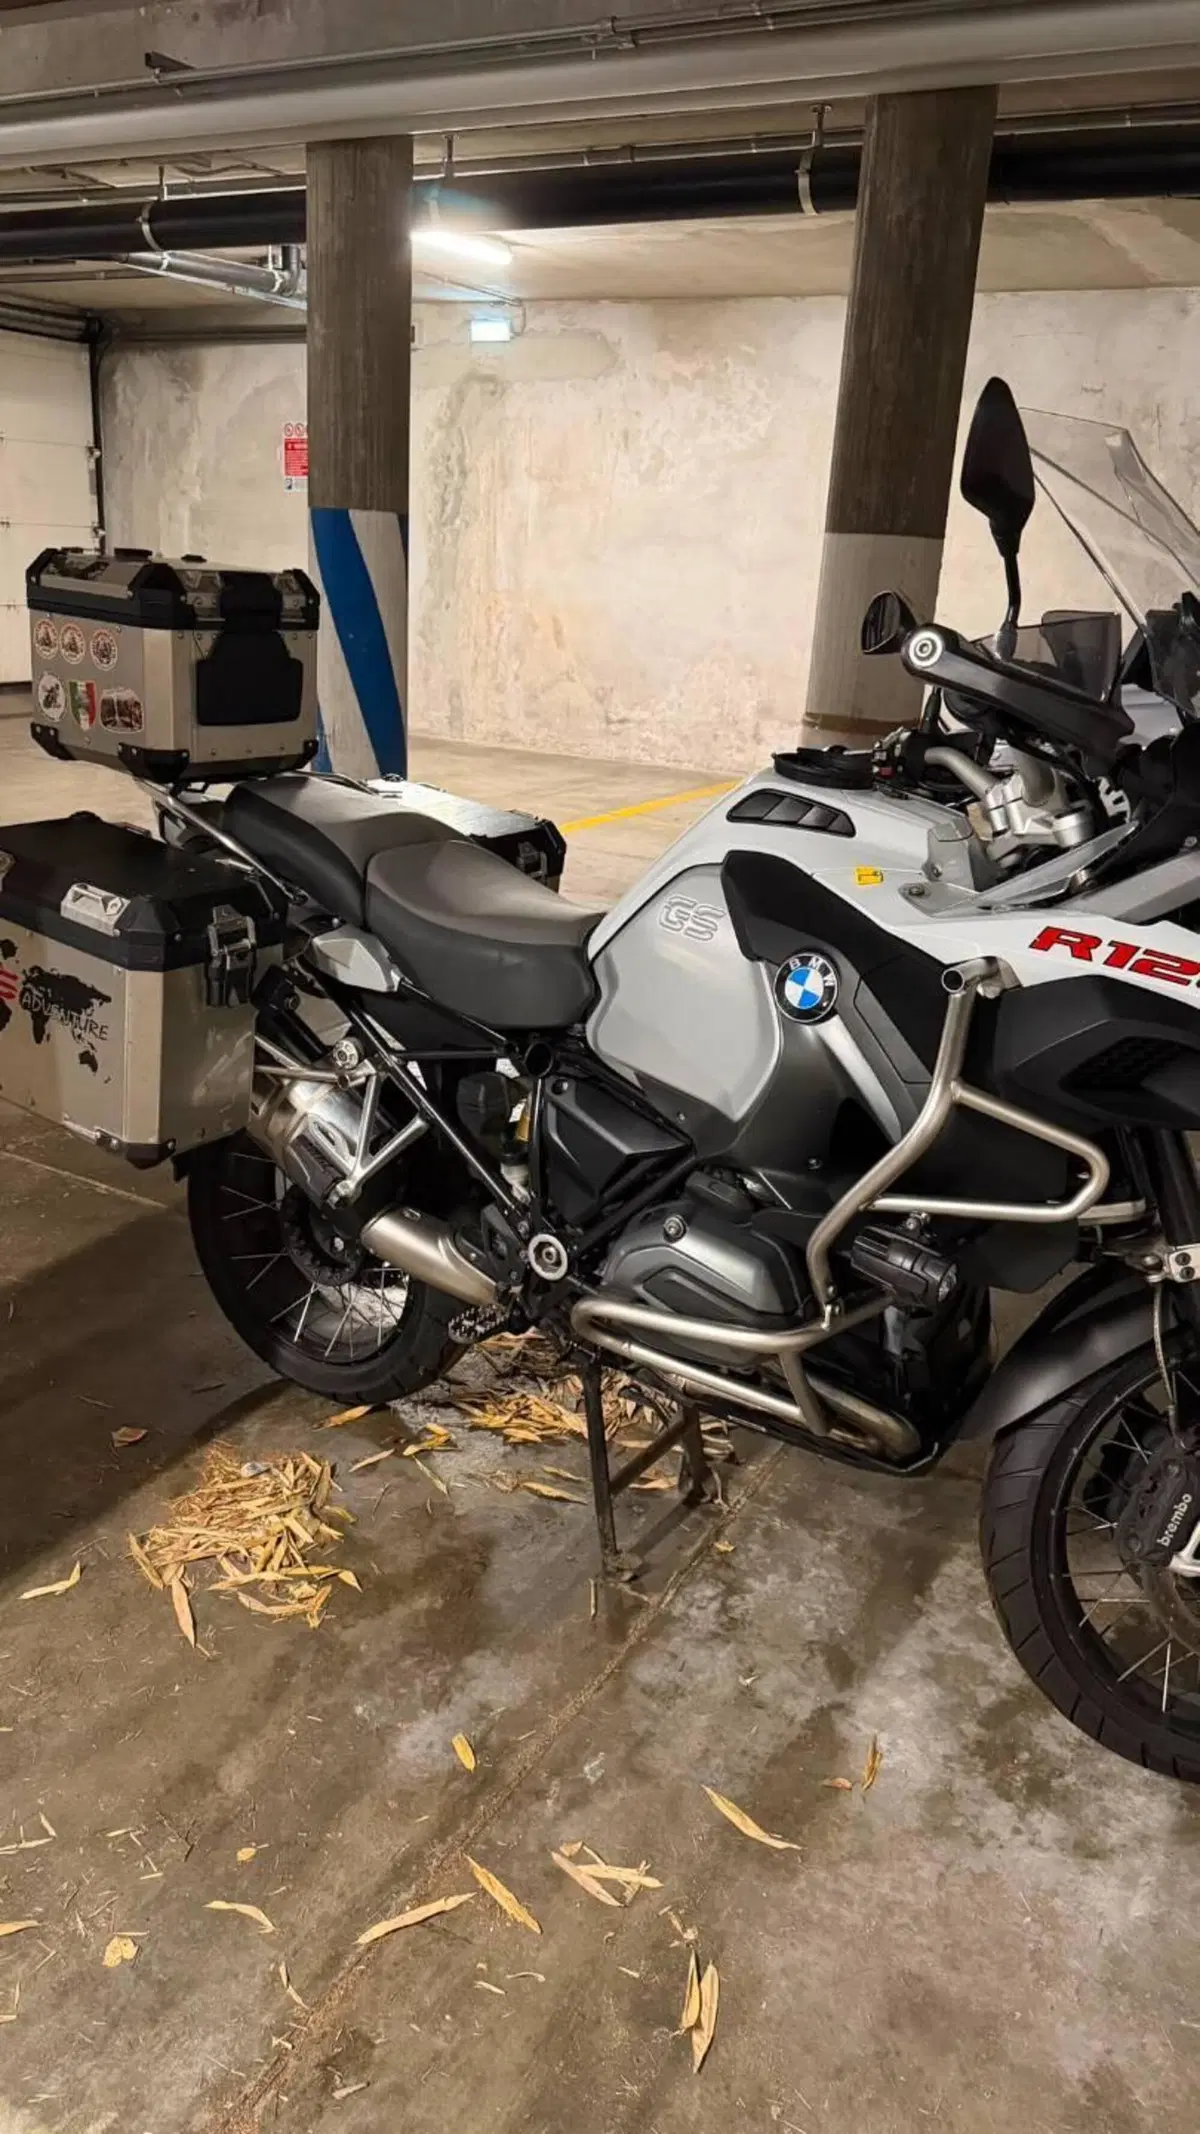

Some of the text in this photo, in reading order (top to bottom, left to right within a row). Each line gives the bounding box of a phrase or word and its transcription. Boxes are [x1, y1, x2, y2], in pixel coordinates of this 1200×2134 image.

[658, 895, 726, 941] GS
[789, 956, 836, 987] BMW
[1028, 925, 1200, 988] R12
[22, 991, 109, 1041] ADVENTURE
[1156, 1493, 1192, 1548] brembo
